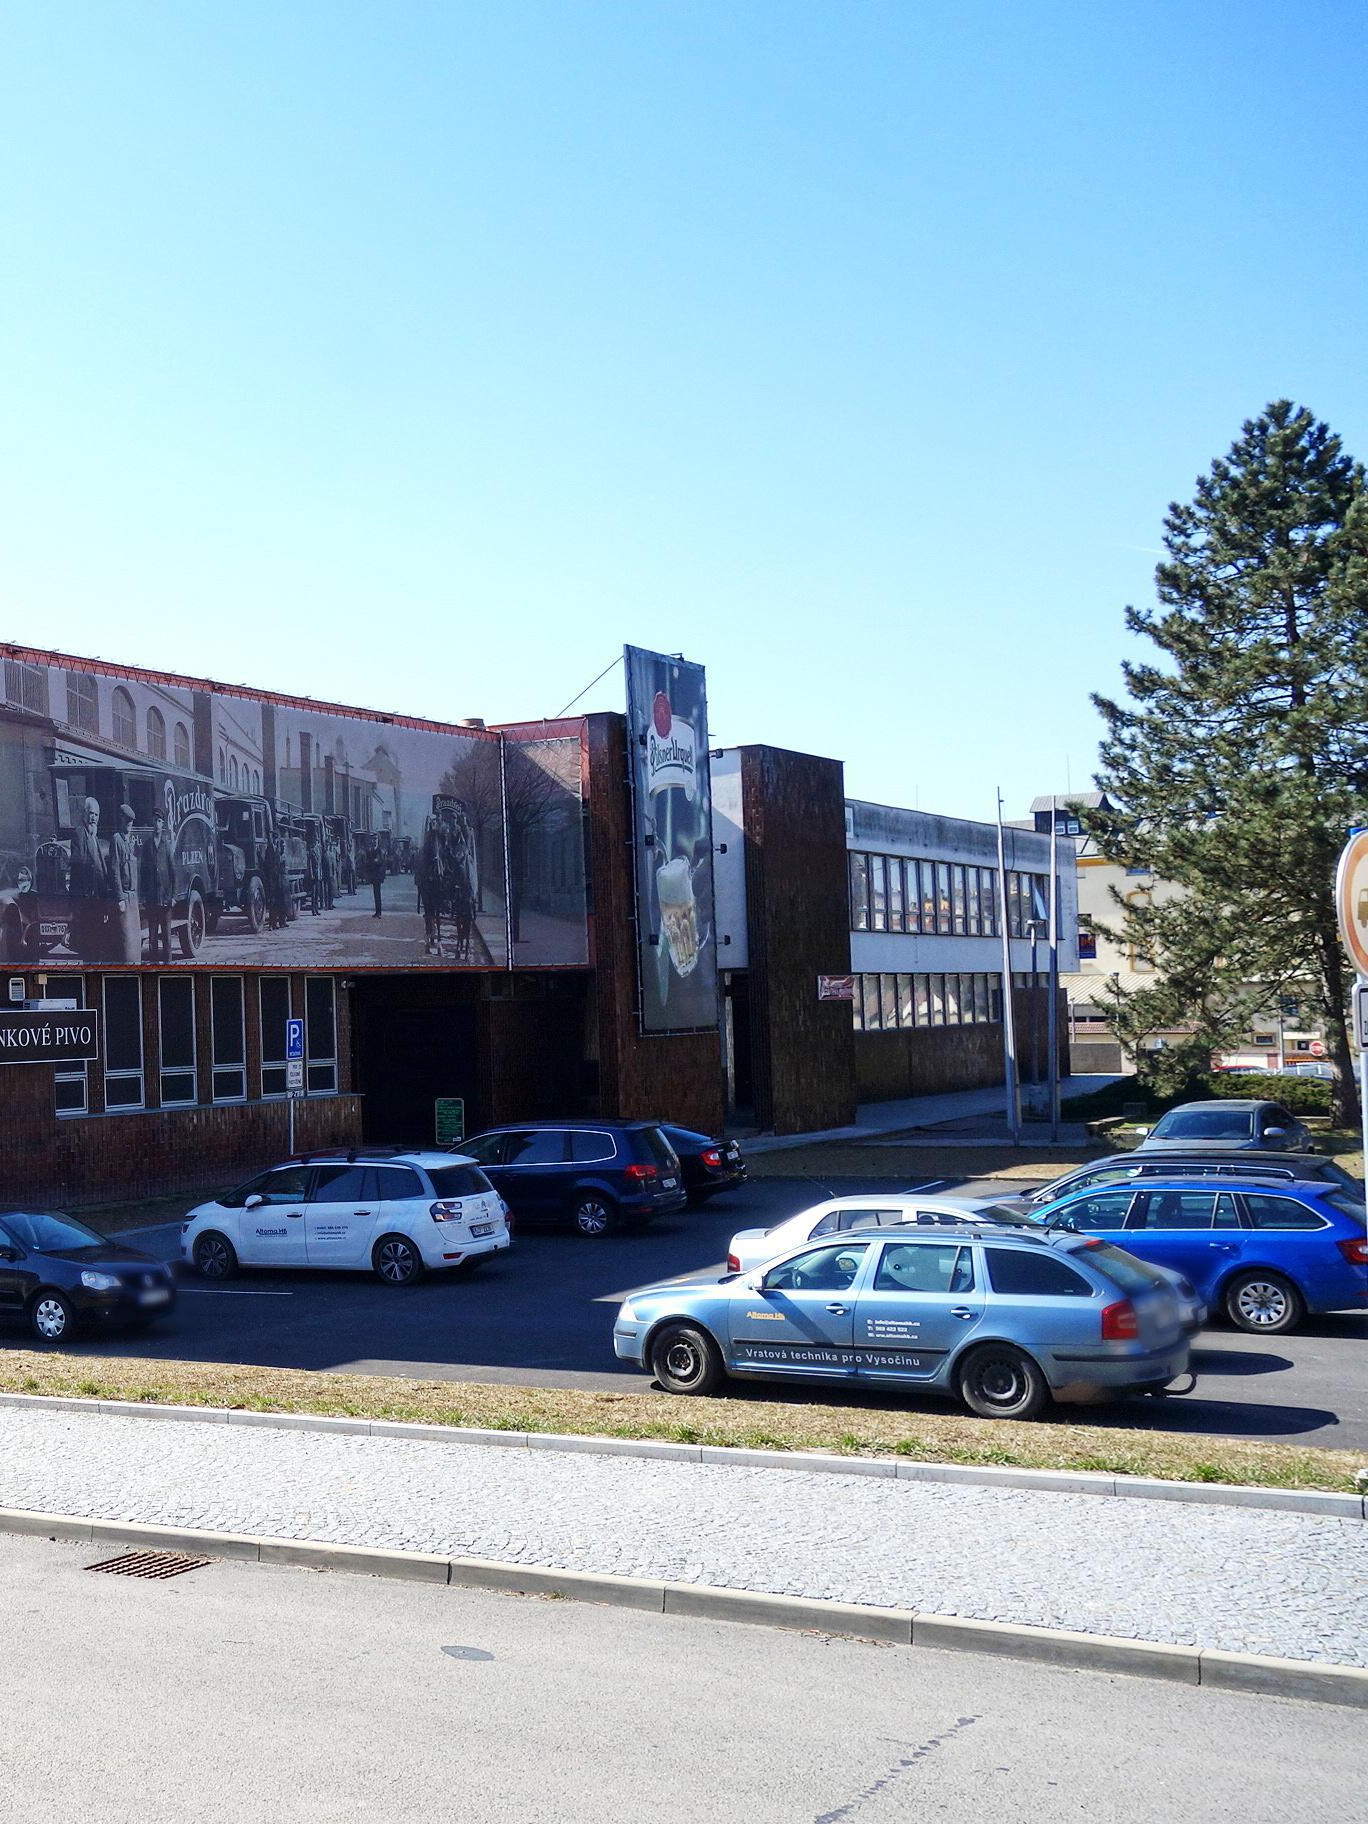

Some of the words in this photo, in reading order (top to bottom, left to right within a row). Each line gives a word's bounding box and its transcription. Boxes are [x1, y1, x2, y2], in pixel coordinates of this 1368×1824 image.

[55, 1026, 92, 1046] PIVO
[290, 1024, 300, 1047] P
[745, 1348, 788, 1359] Vratová
[790, 1351, 838, 1362] technika
[841, 1354, 862, 1366] pro
[865, 1351, 921, 1367] Vysočinu
